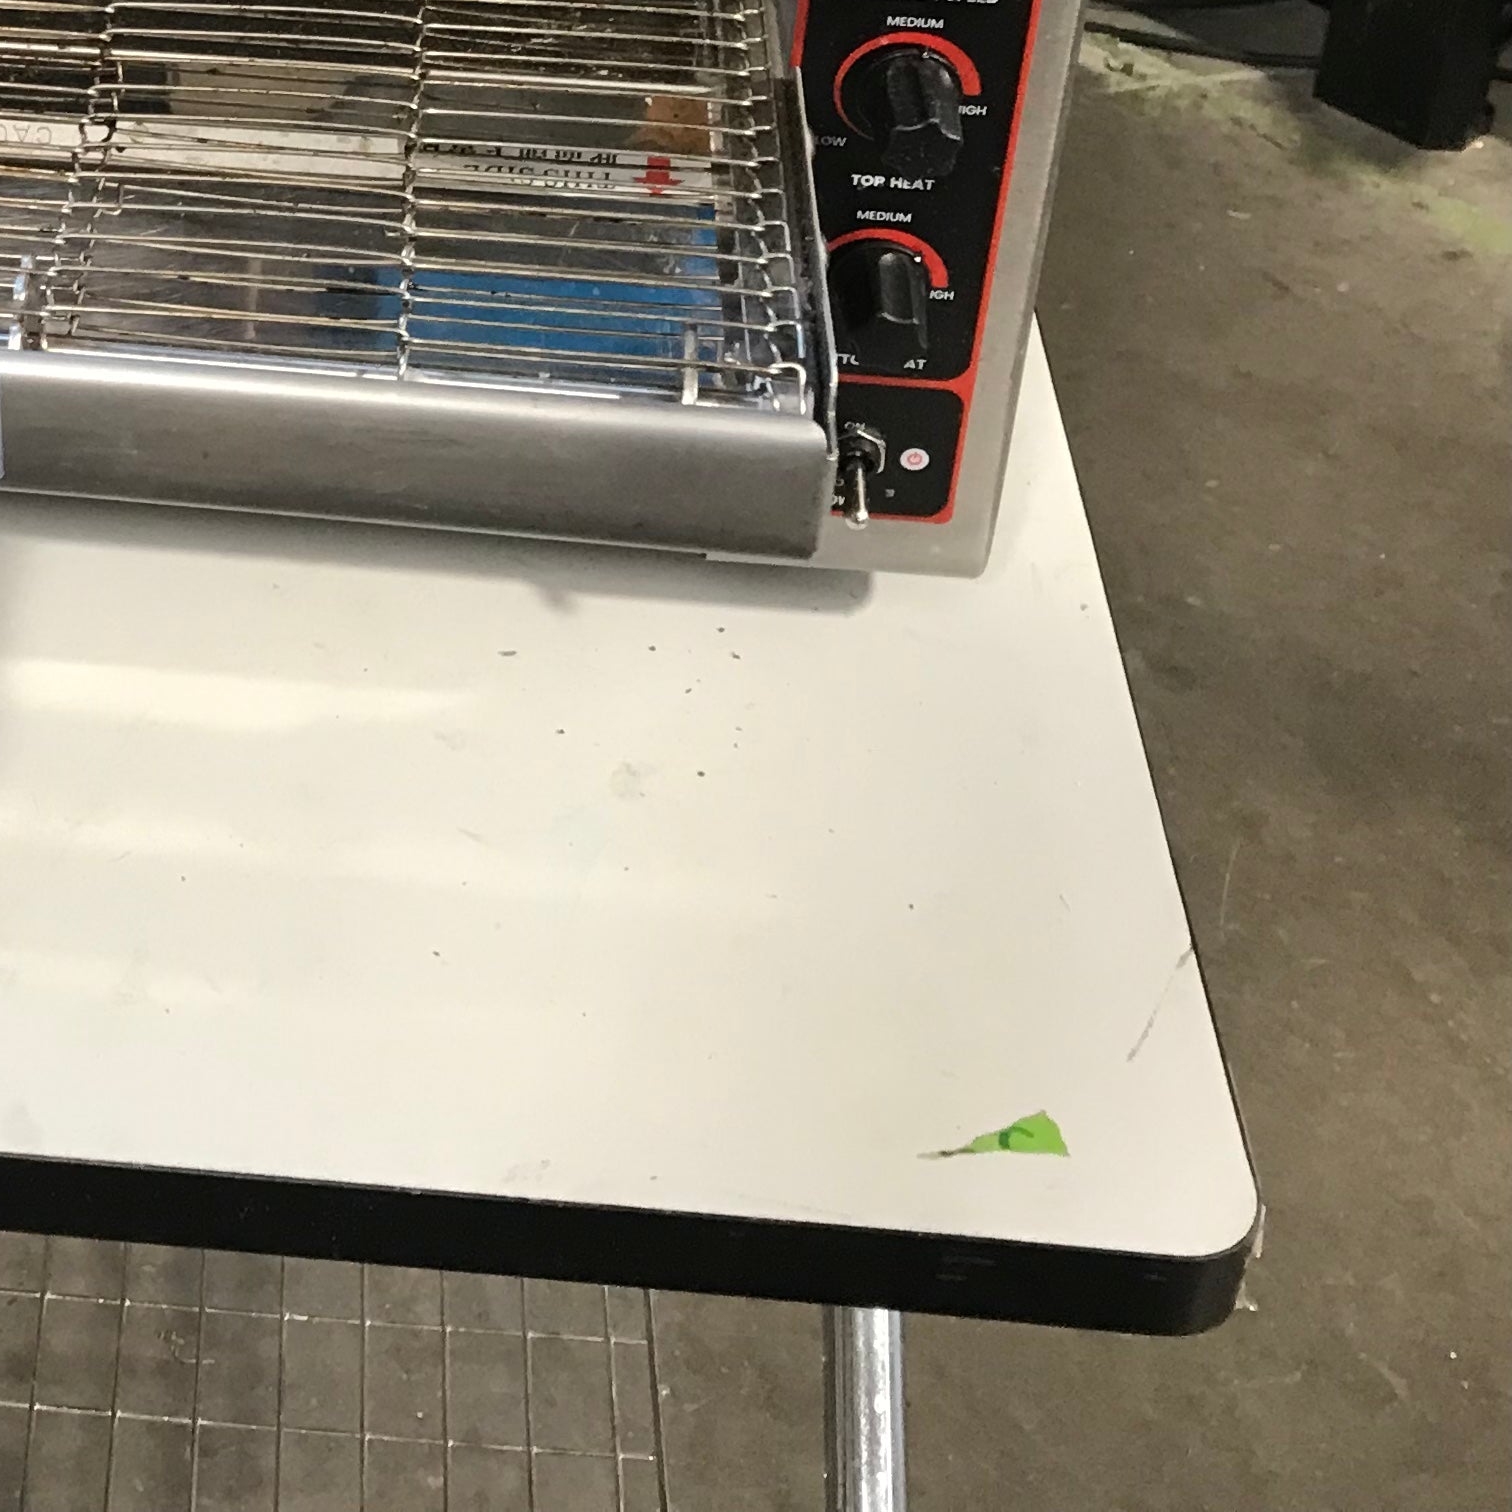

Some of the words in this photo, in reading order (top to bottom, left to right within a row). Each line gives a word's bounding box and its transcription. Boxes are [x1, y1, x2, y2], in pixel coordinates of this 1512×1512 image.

[886, 16, 944, 29] MEDIUM
[851, 174, 885, 187] TOP
[856, 210, 912, 223] MEDIUM
